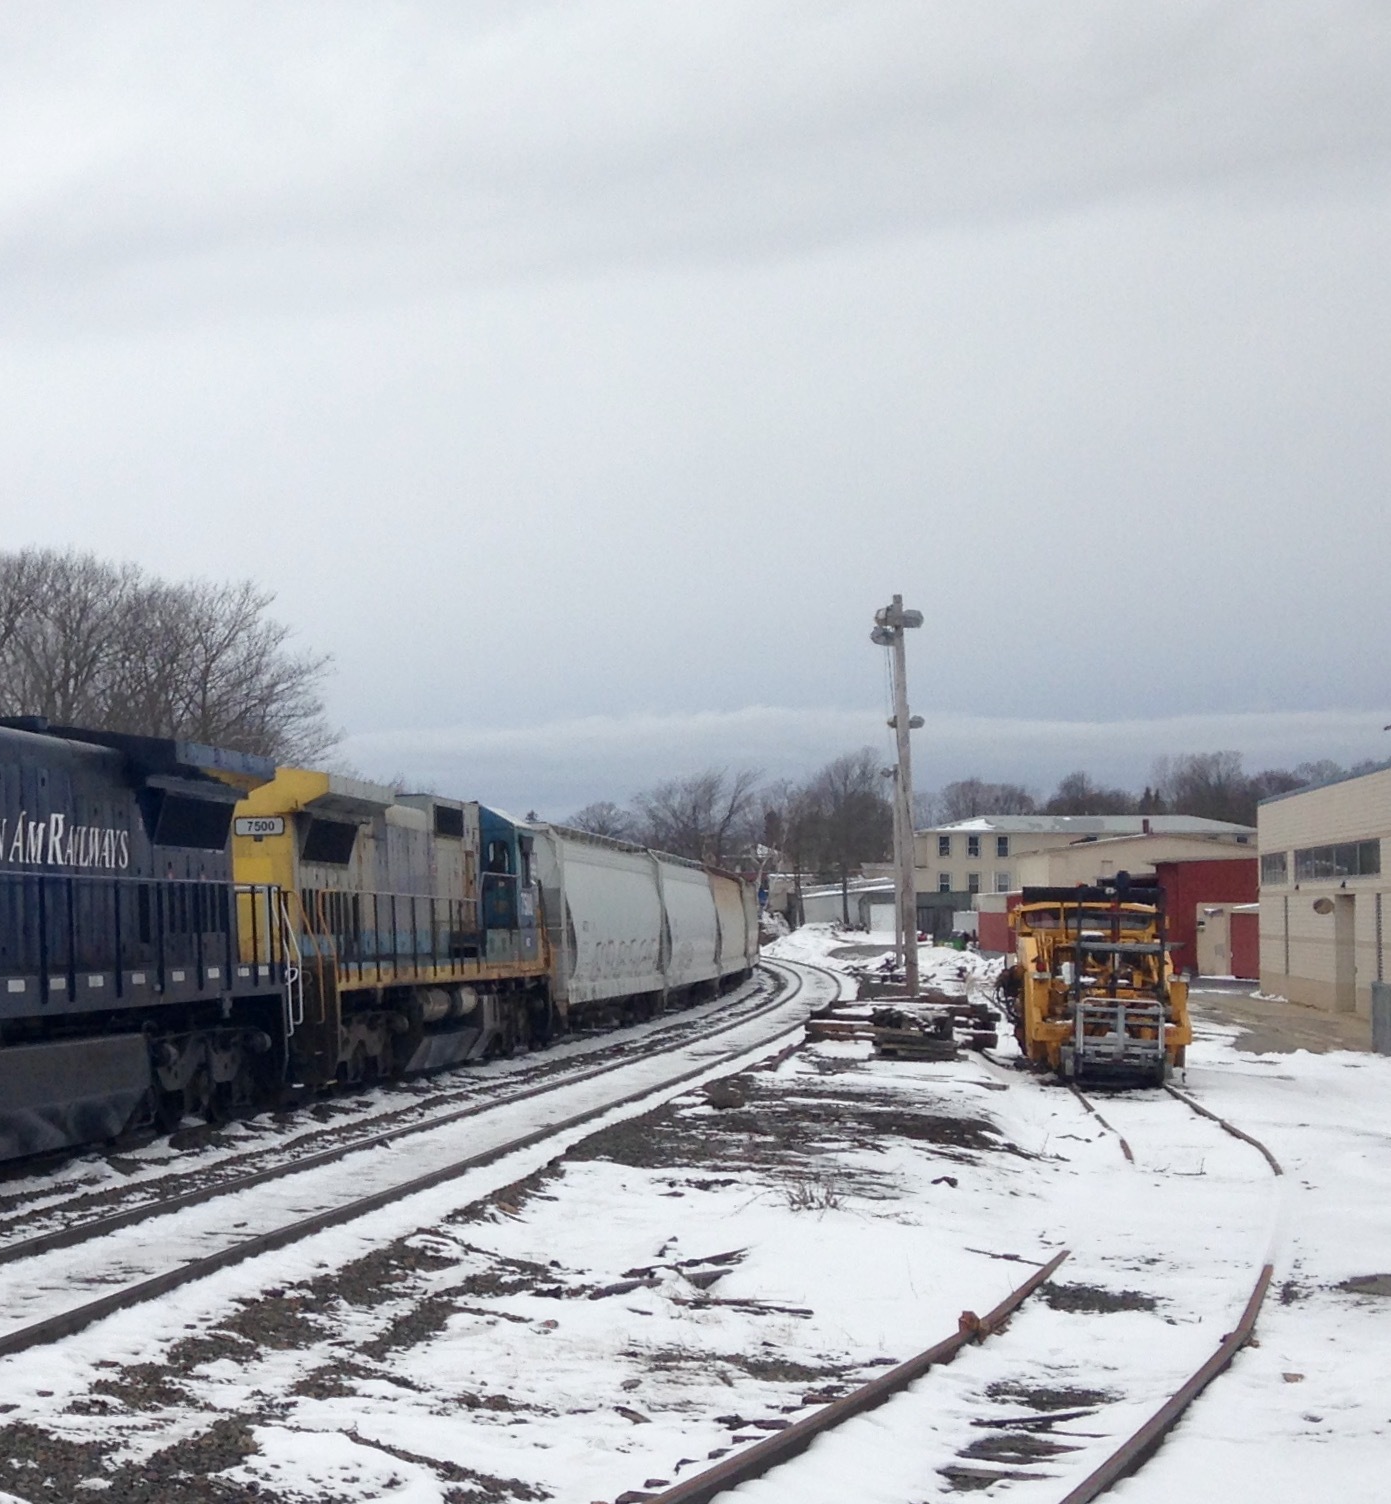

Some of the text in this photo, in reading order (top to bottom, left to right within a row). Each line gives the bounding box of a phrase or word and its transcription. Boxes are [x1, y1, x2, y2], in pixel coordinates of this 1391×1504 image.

[8, 810, 45, 864] AM
[47, 813, 129, 869] RAILWAYS
[247, 820, 275, 832] 7500
